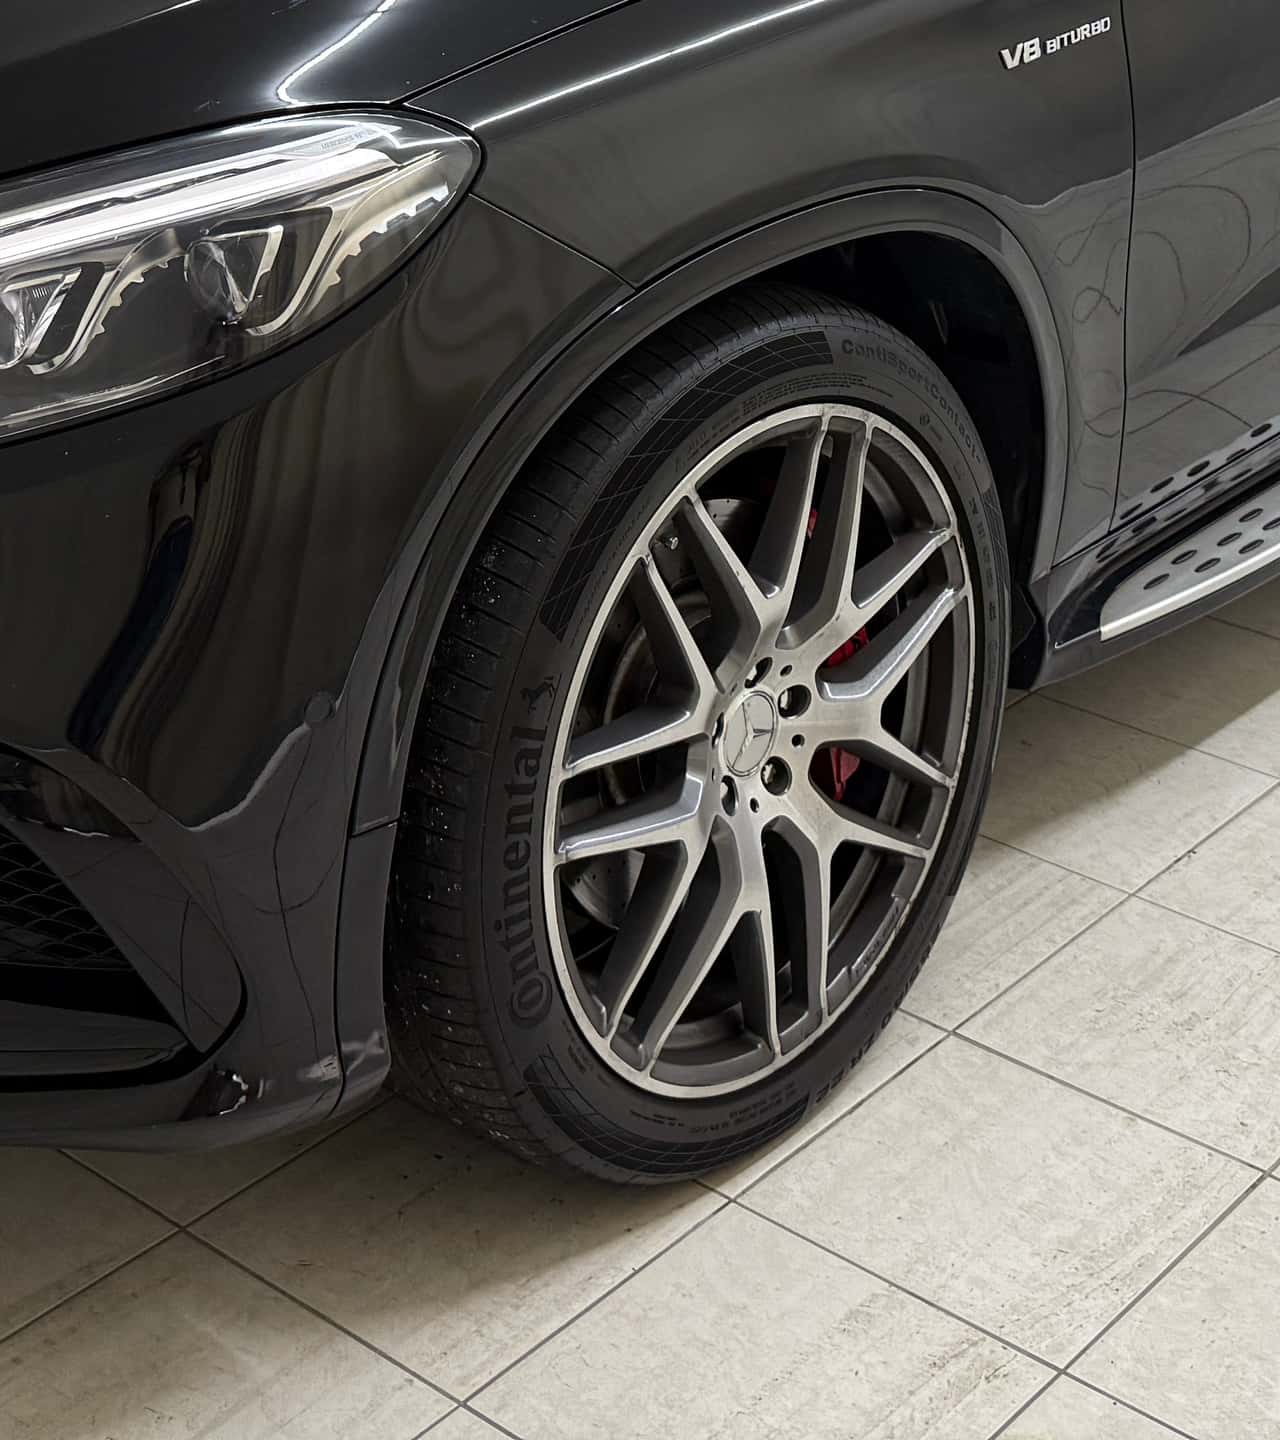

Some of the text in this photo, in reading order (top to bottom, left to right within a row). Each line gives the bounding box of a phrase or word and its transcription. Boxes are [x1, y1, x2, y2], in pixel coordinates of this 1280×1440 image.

[999, 16, 1111, 70] V8 BITURBO
[495, 724, 553, 1030] Continental
